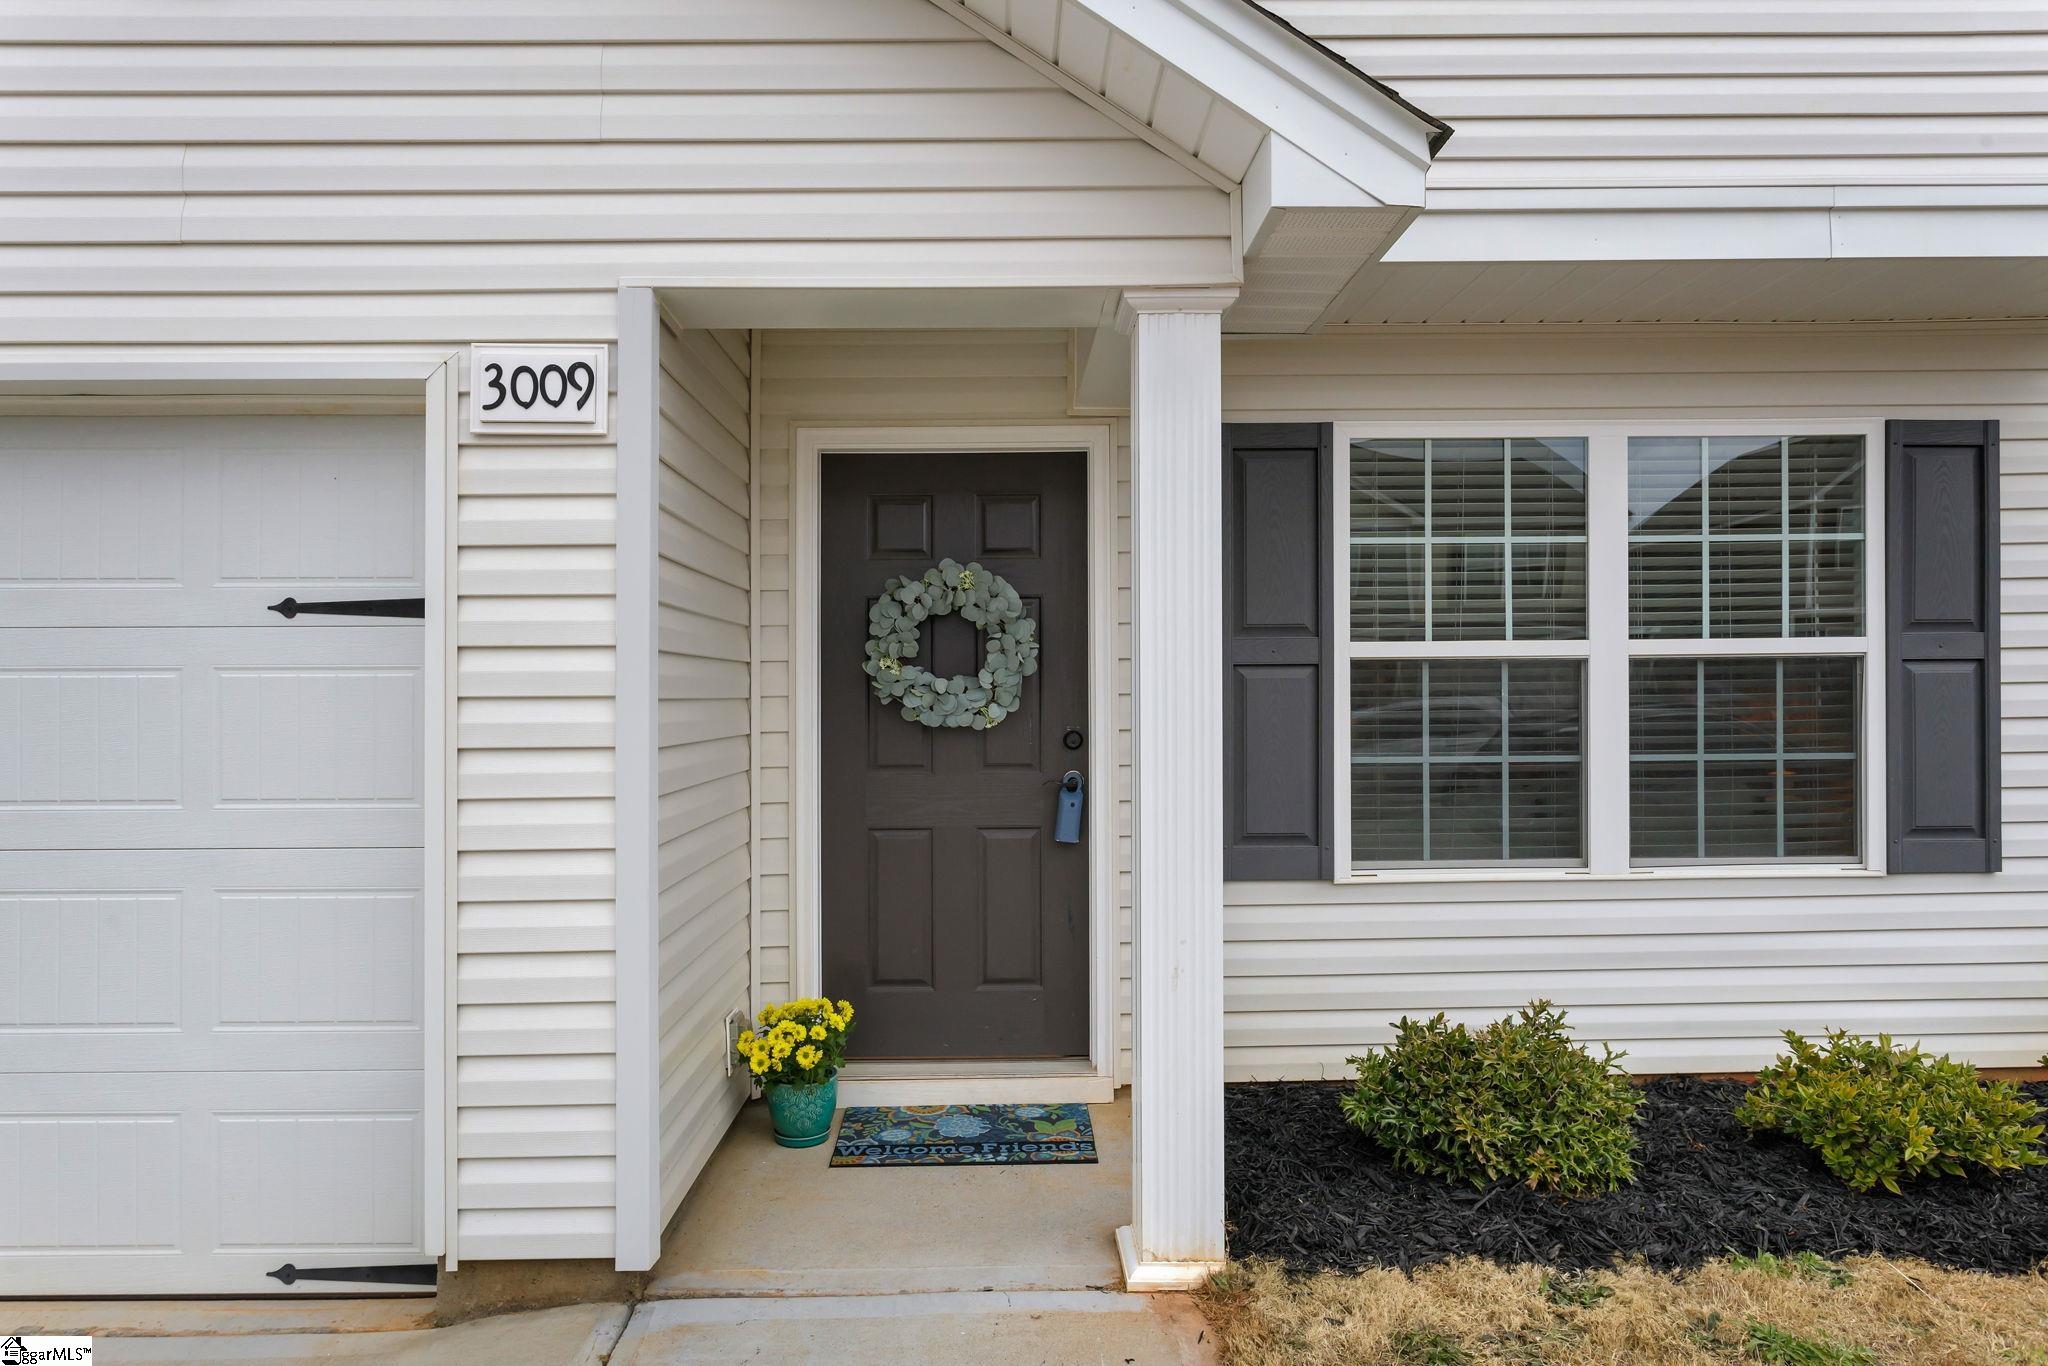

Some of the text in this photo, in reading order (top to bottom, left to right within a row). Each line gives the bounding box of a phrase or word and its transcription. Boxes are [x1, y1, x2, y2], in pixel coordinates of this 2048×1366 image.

[482, 361, 595, 411] 3009
[837, 1142, 1094, 1156] Welcome Friends
